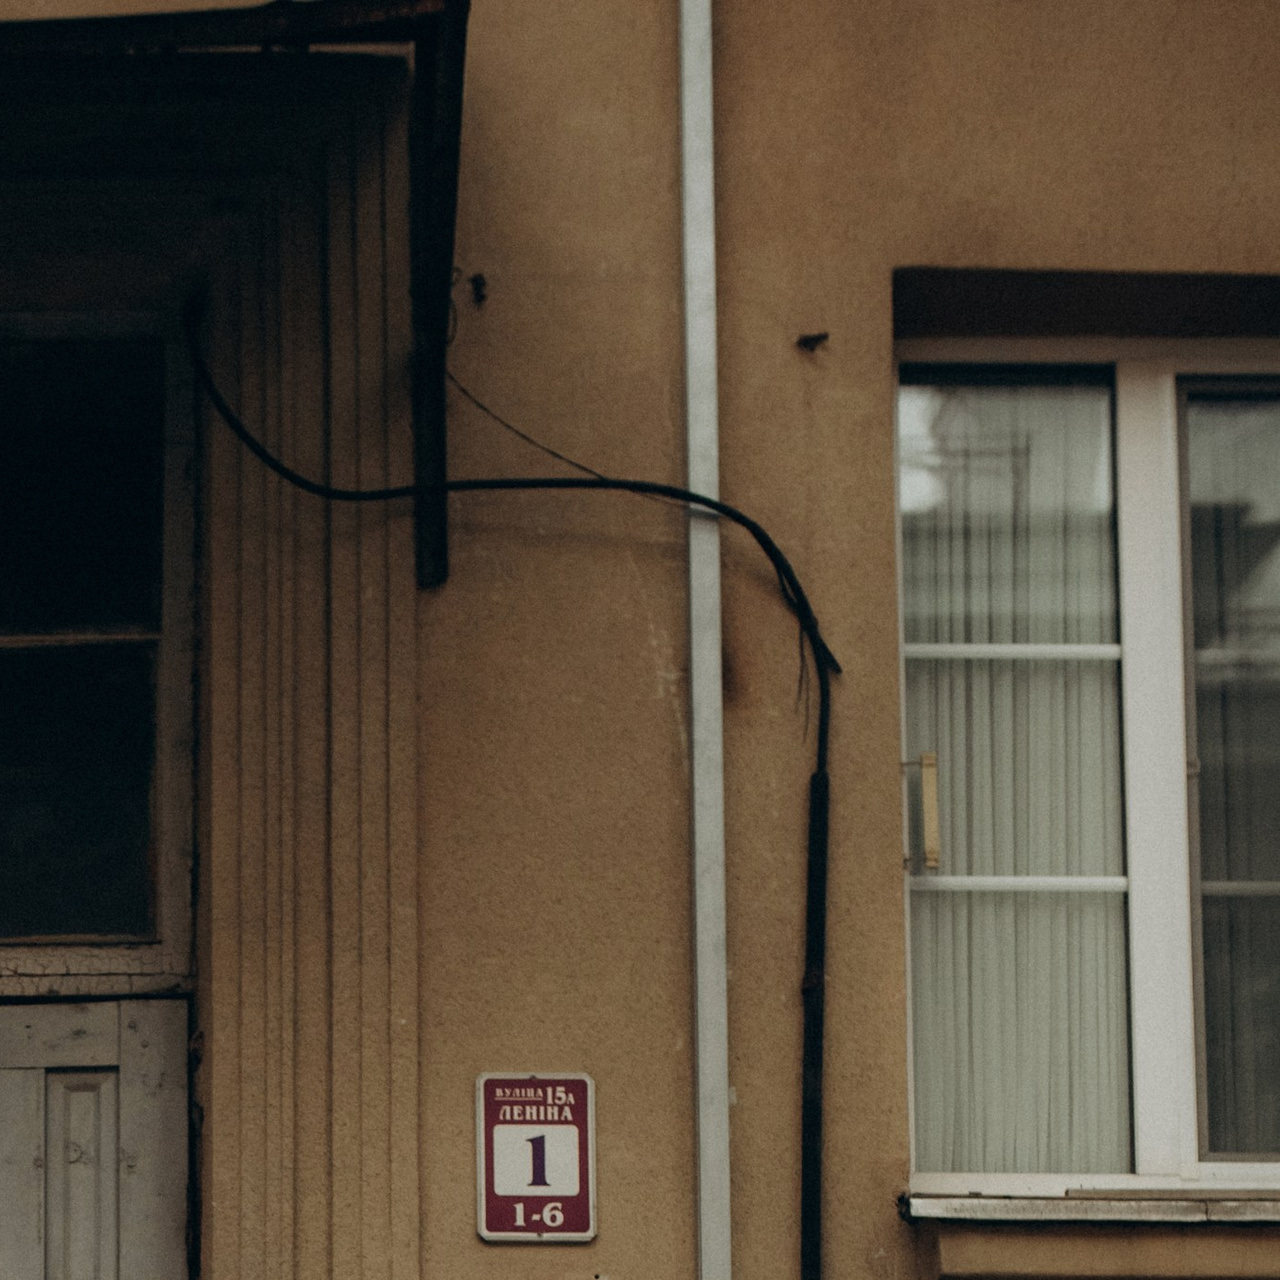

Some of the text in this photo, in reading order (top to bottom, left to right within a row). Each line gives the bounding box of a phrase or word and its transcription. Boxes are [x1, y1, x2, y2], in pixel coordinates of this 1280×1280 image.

[495, 1088, 543, 1098] ВУЛІЦА
[498, 1105, 574, 1121] ЛЕНІНА
[525, 1134, 551, 1187] 1
[513, 1202, 565, 1228] 1-6
